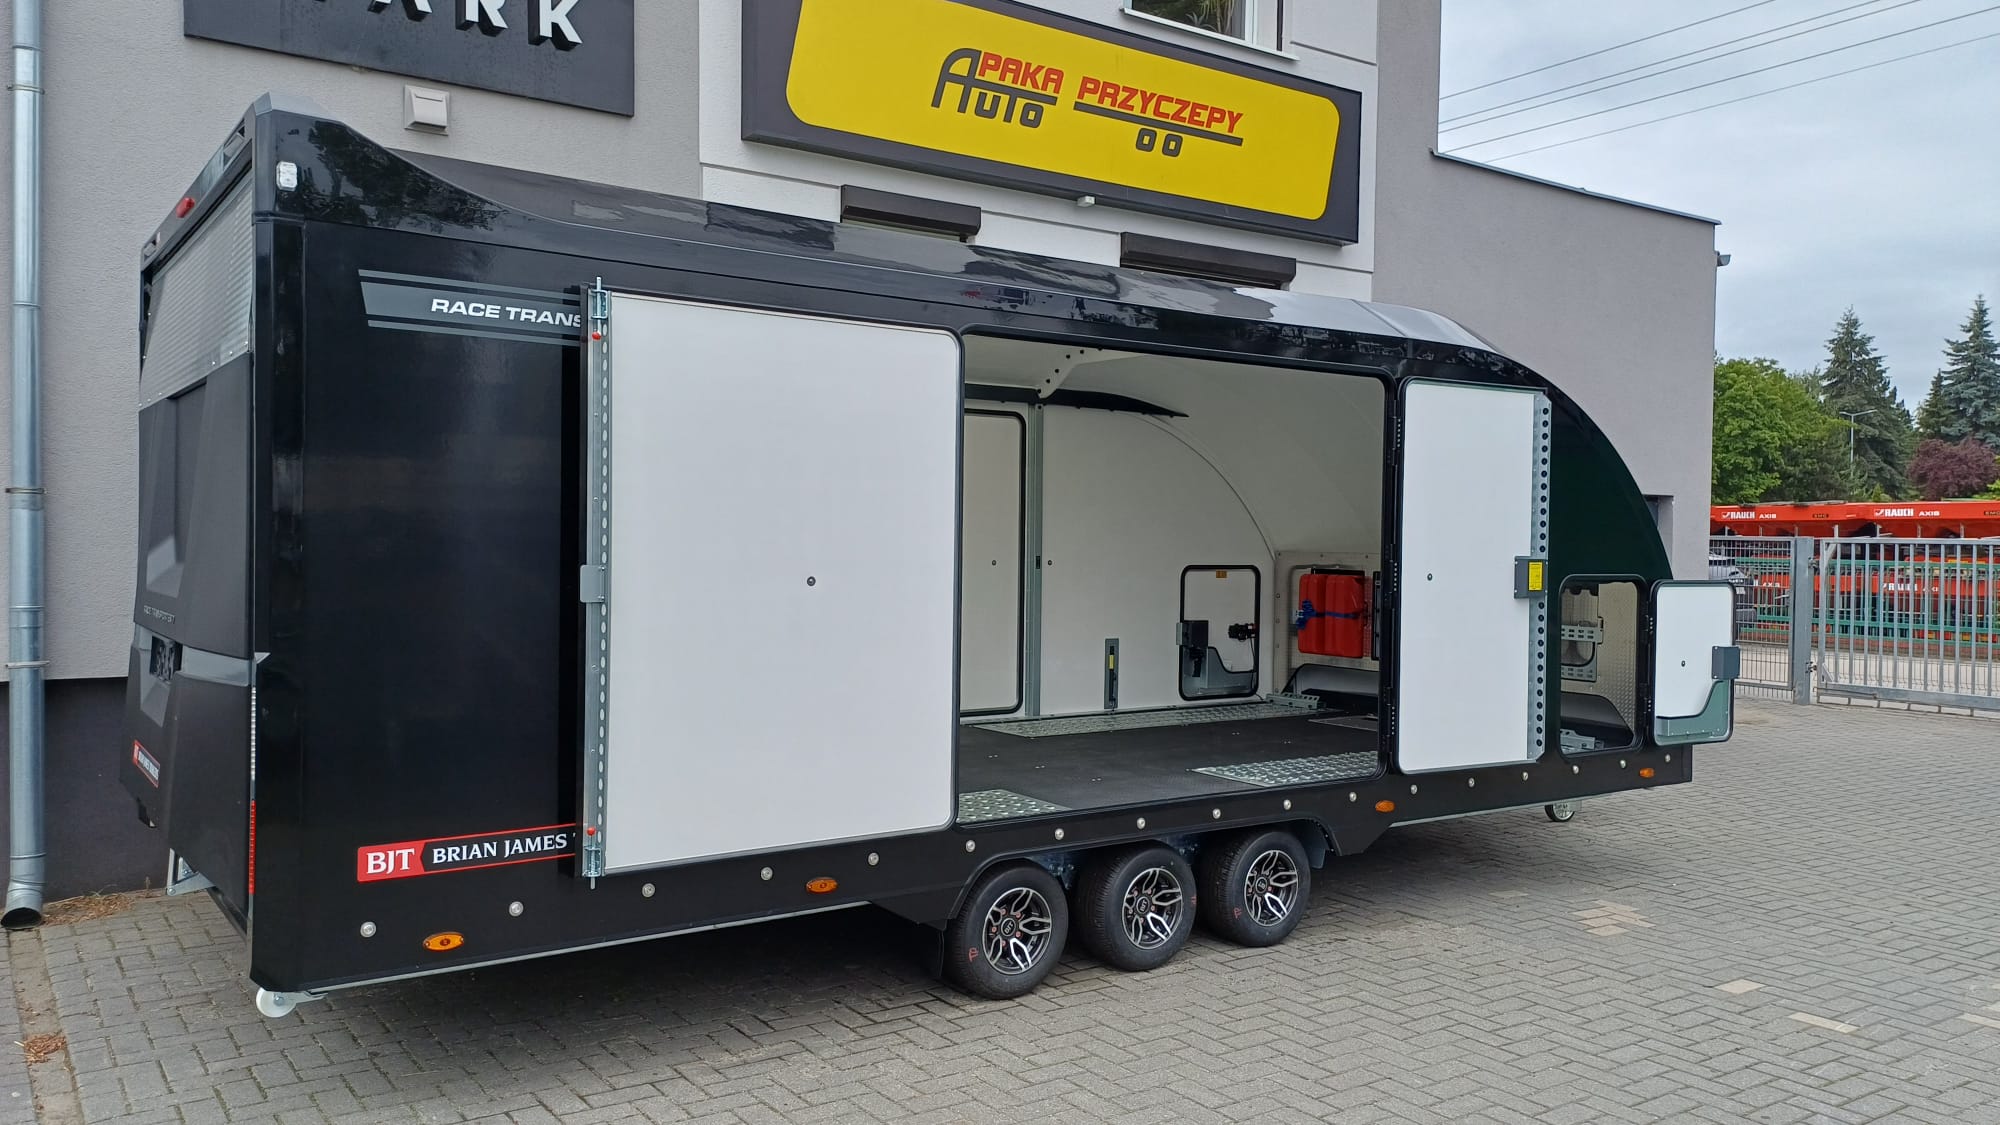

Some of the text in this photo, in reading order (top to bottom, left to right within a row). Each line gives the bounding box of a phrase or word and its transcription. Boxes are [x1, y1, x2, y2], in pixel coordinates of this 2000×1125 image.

[1077, 75, 1244, 133] PRZYCZEPY
[431, 298, 500, 319] RACE
[1730, 511, 1755, 519] RAUCH
[1884, 508, 1915, 517] RAUCH
[366, 832, 568, 874] BJT BRIAN JAMES
